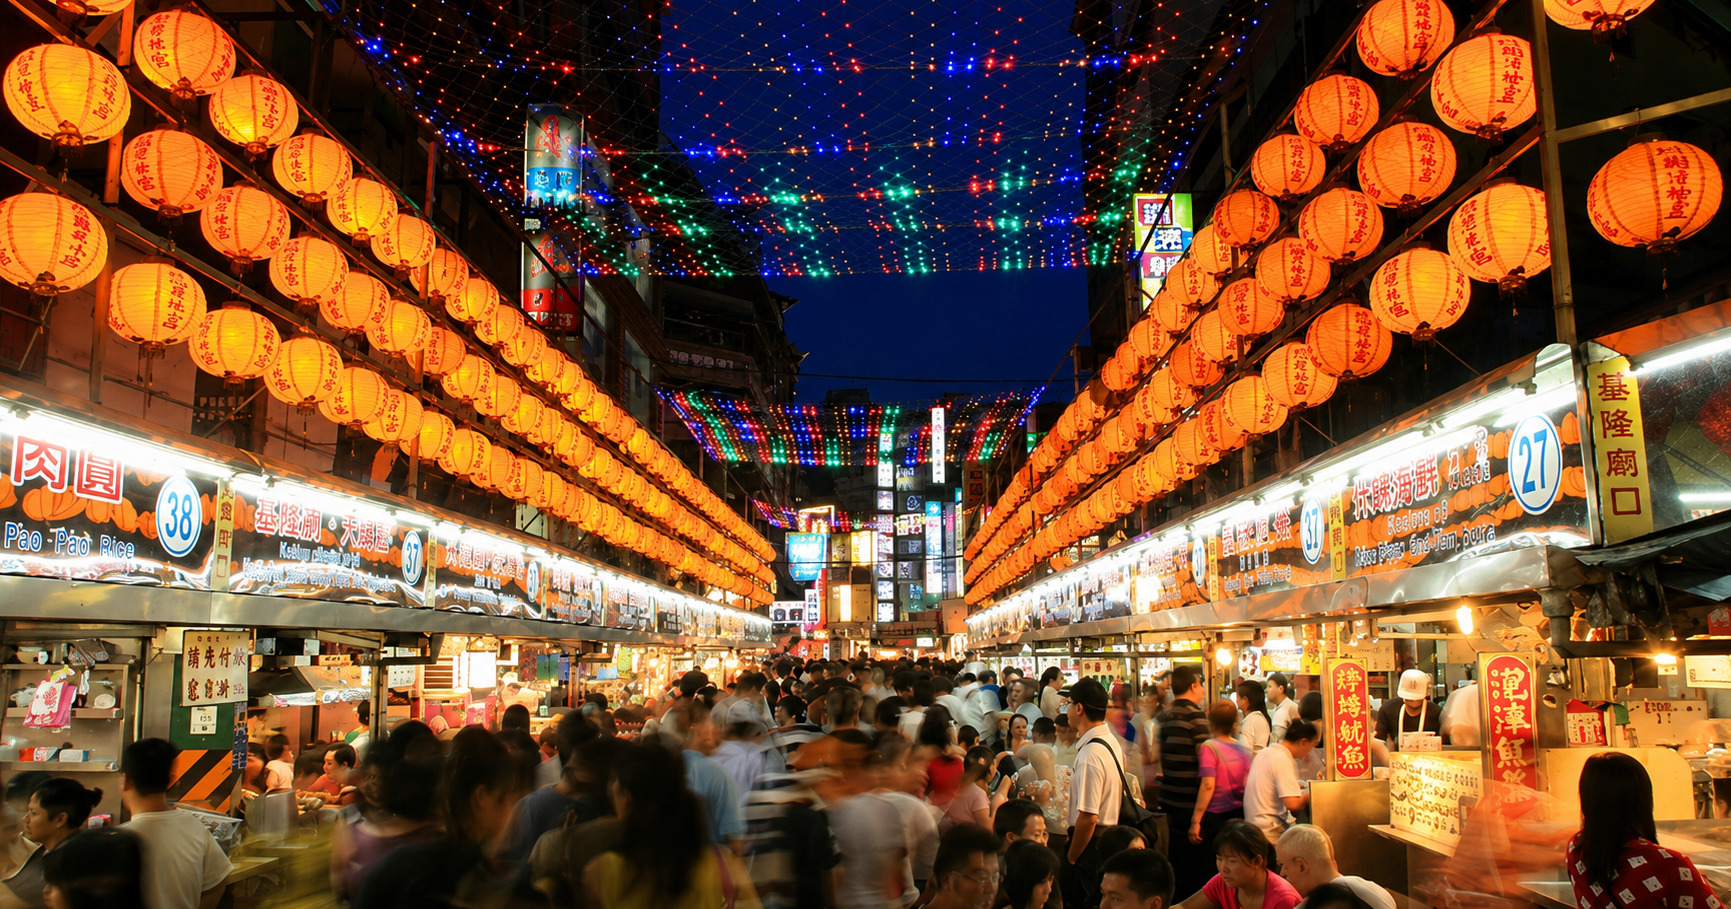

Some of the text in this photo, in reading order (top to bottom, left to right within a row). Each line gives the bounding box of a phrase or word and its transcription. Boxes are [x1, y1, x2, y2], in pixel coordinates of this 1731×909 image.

[1518, 427, 1548, 495] 27
[1597, 371, 1642, 516] 基隆廟口
[12, 435, 124, 503] 肉圓
[3, 520, 43, 552] Pao
[54, 528, 90, 557] Pao
[165, 491, 193, 541] 38
[1304, 507, 1319, 551] 37
[405, 541, 419, 575] 37
